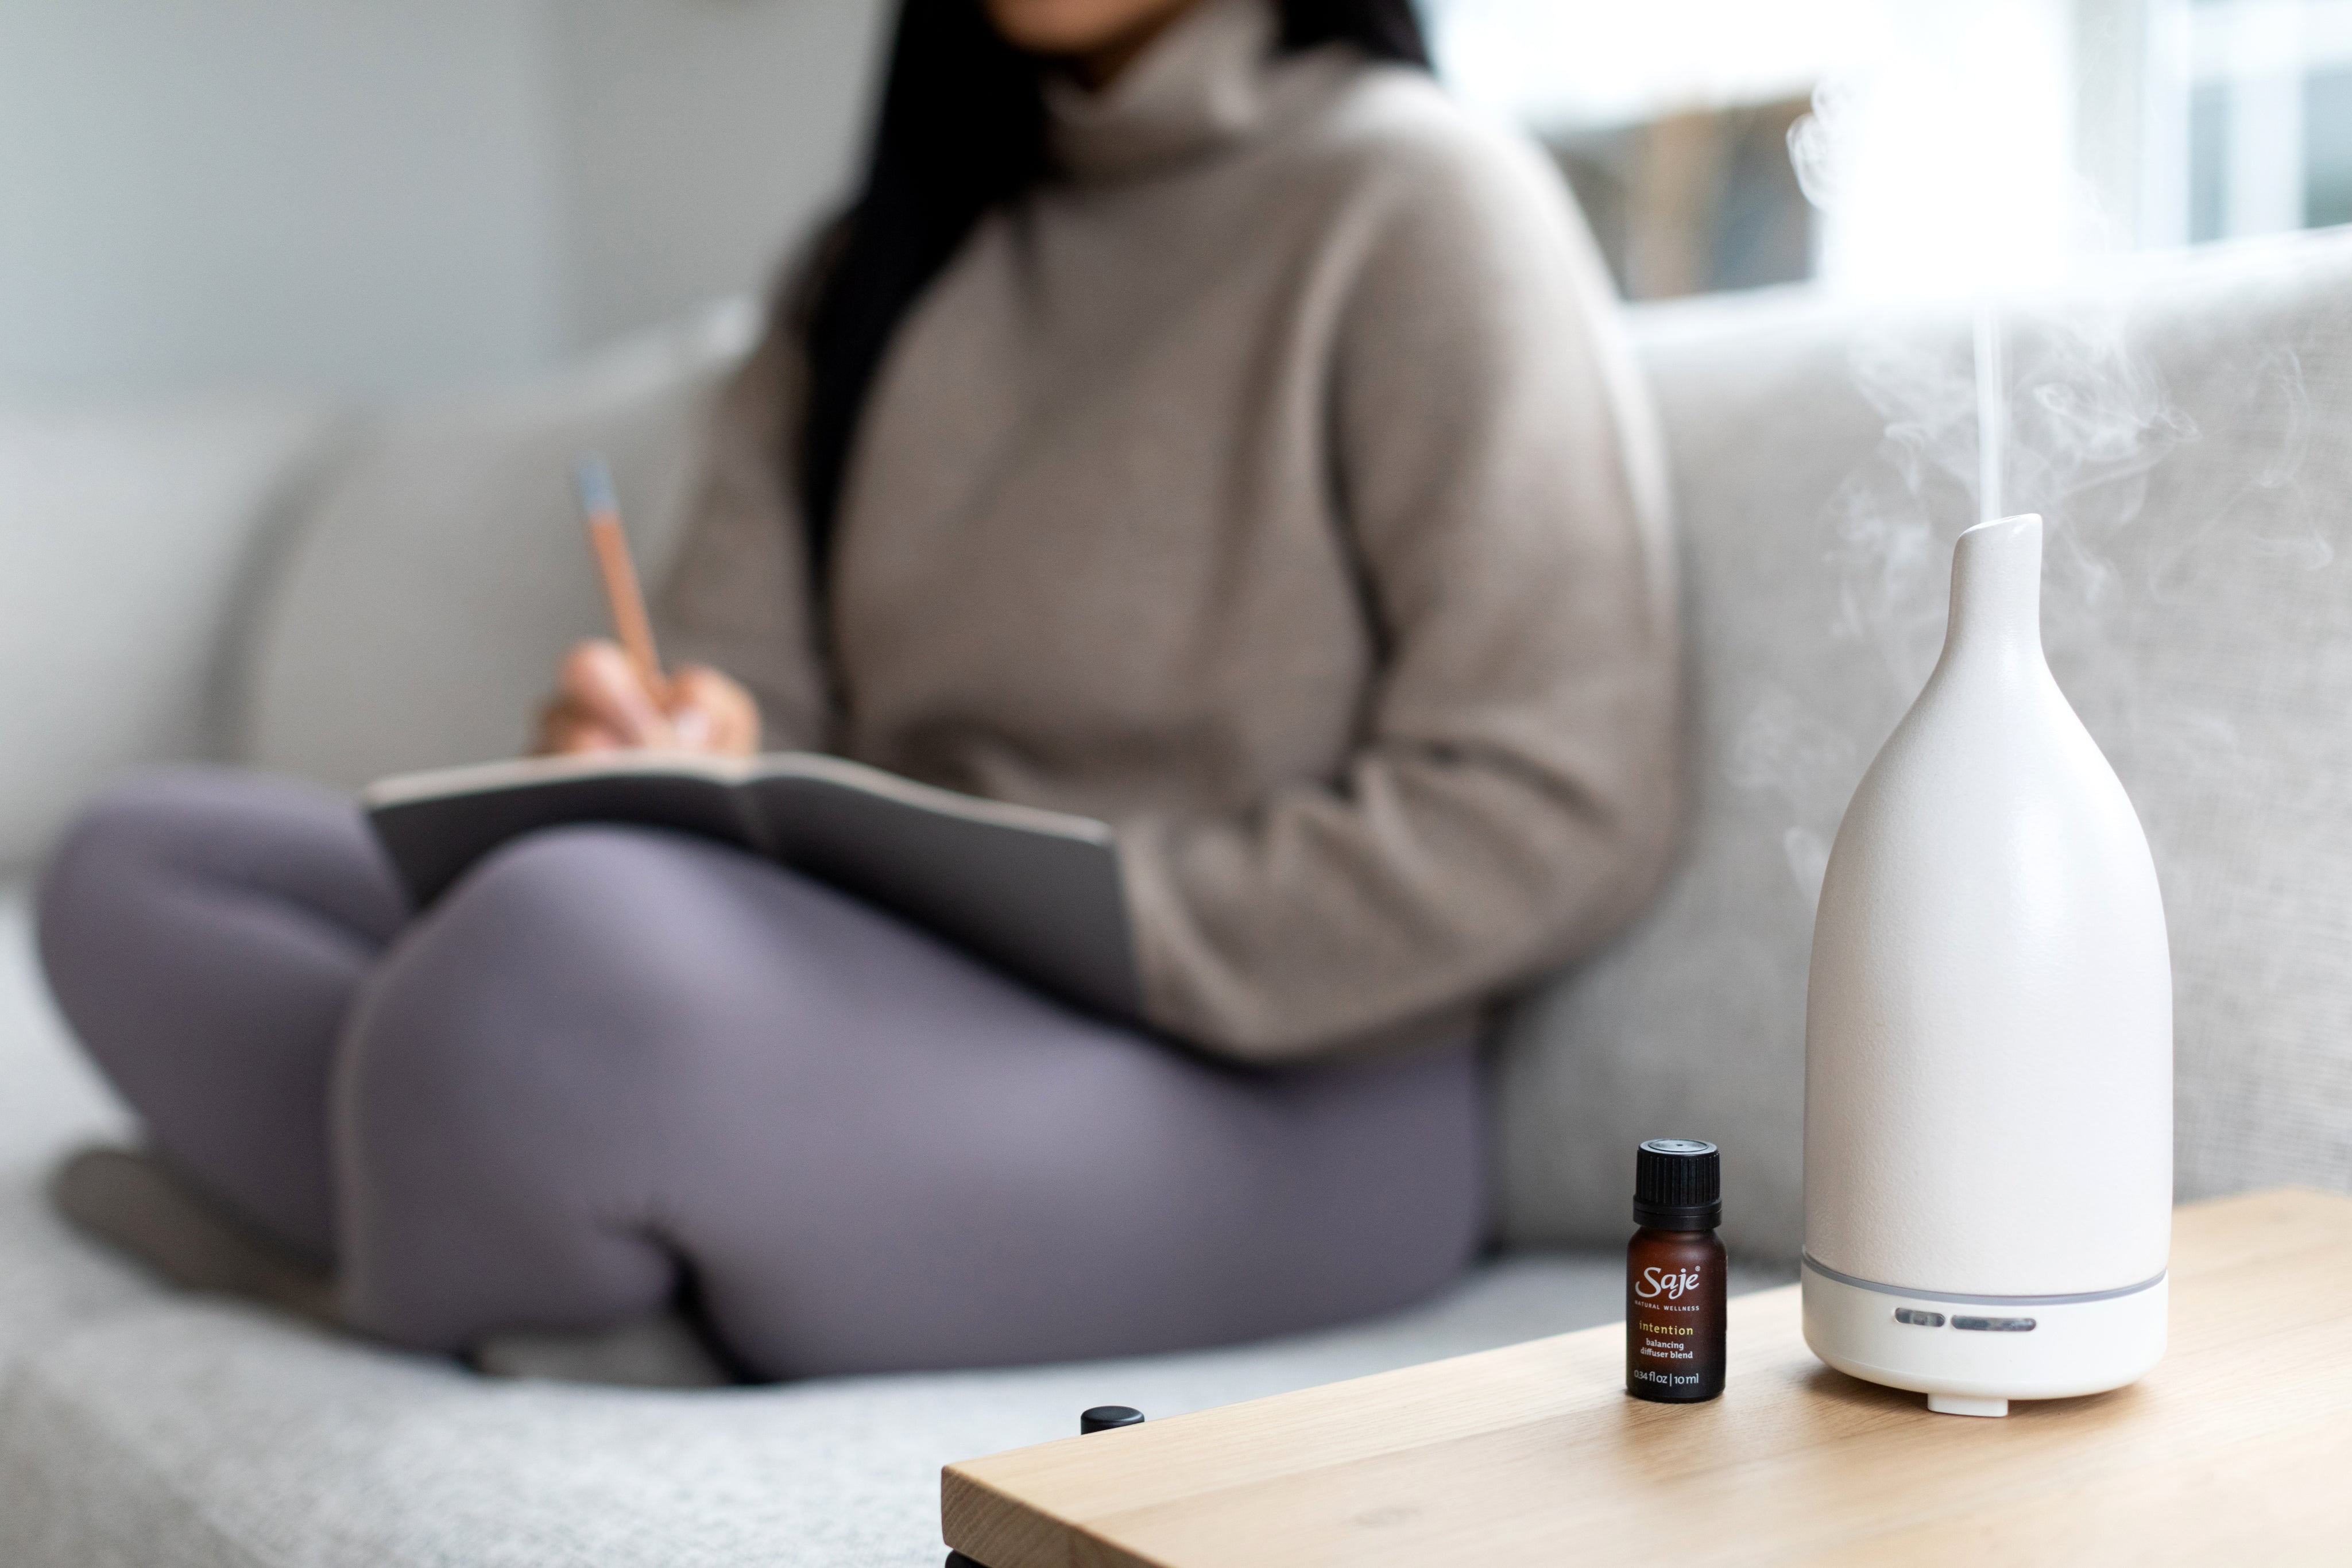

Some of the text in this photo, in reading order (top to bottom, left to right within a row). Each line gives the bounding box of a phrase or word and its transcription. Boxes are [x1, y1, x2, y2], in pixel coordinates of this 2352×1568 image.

[1634, 1300, 1660, 1310] NATURAL
[1639, 1320, 1693, 1335] intention
[1646, 1338, 1684, 1350] balancing
[1640, 1347, 1668, 1358] diffuser
